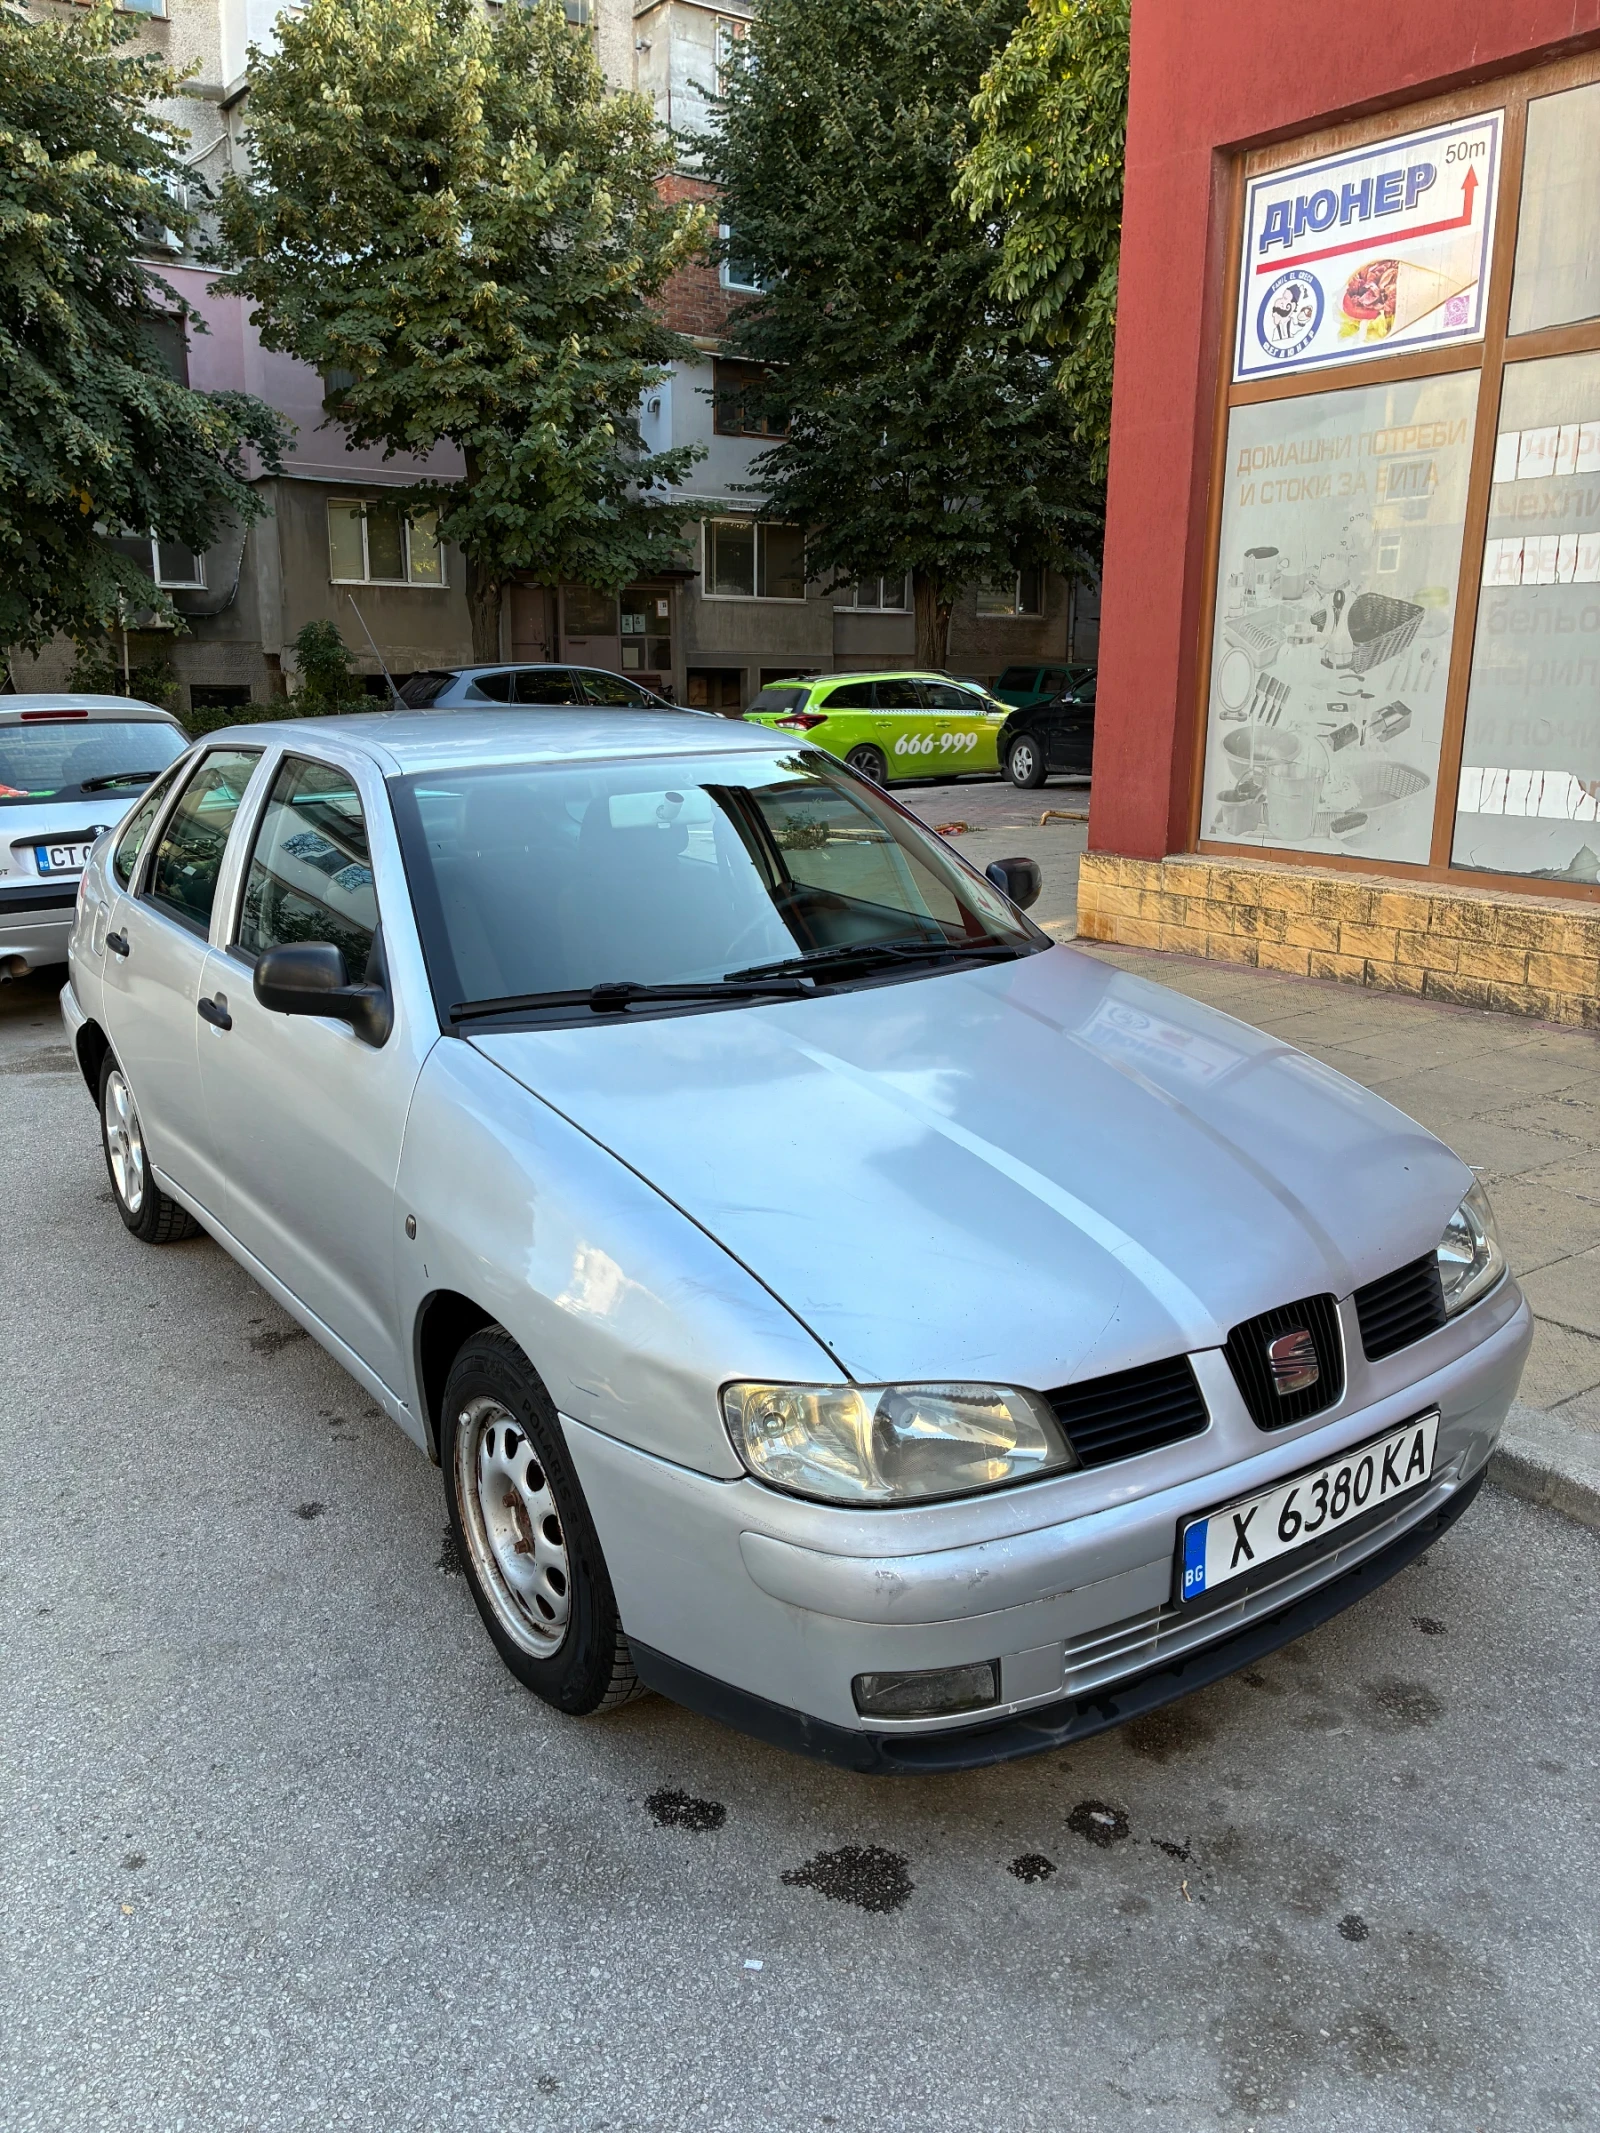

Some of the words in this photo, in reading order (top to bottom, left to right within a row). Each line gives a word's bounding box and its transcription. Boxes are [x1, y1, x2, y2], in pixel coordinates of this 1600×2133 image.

[1445, 141, 1486, 165] 50m
[1259, 162, 1437, 254] ДЮНЕР
[1237, 434, 1352, 477] ДОМАШНИ
[1358, 418, 1468, 457] ПОТРЕБИ
[1240, 484, 1255, 507] И
[1260, 475, 1332, 505] СТОКИ
[1337, 470, 1368, 496] ЗА
[895, 732, 978, 755] 666-999
[50, 847, 77, 867] CT
[521, 1397, 572, 1503] POLARIS
[1185, 1564, 1203, 1587] BG
